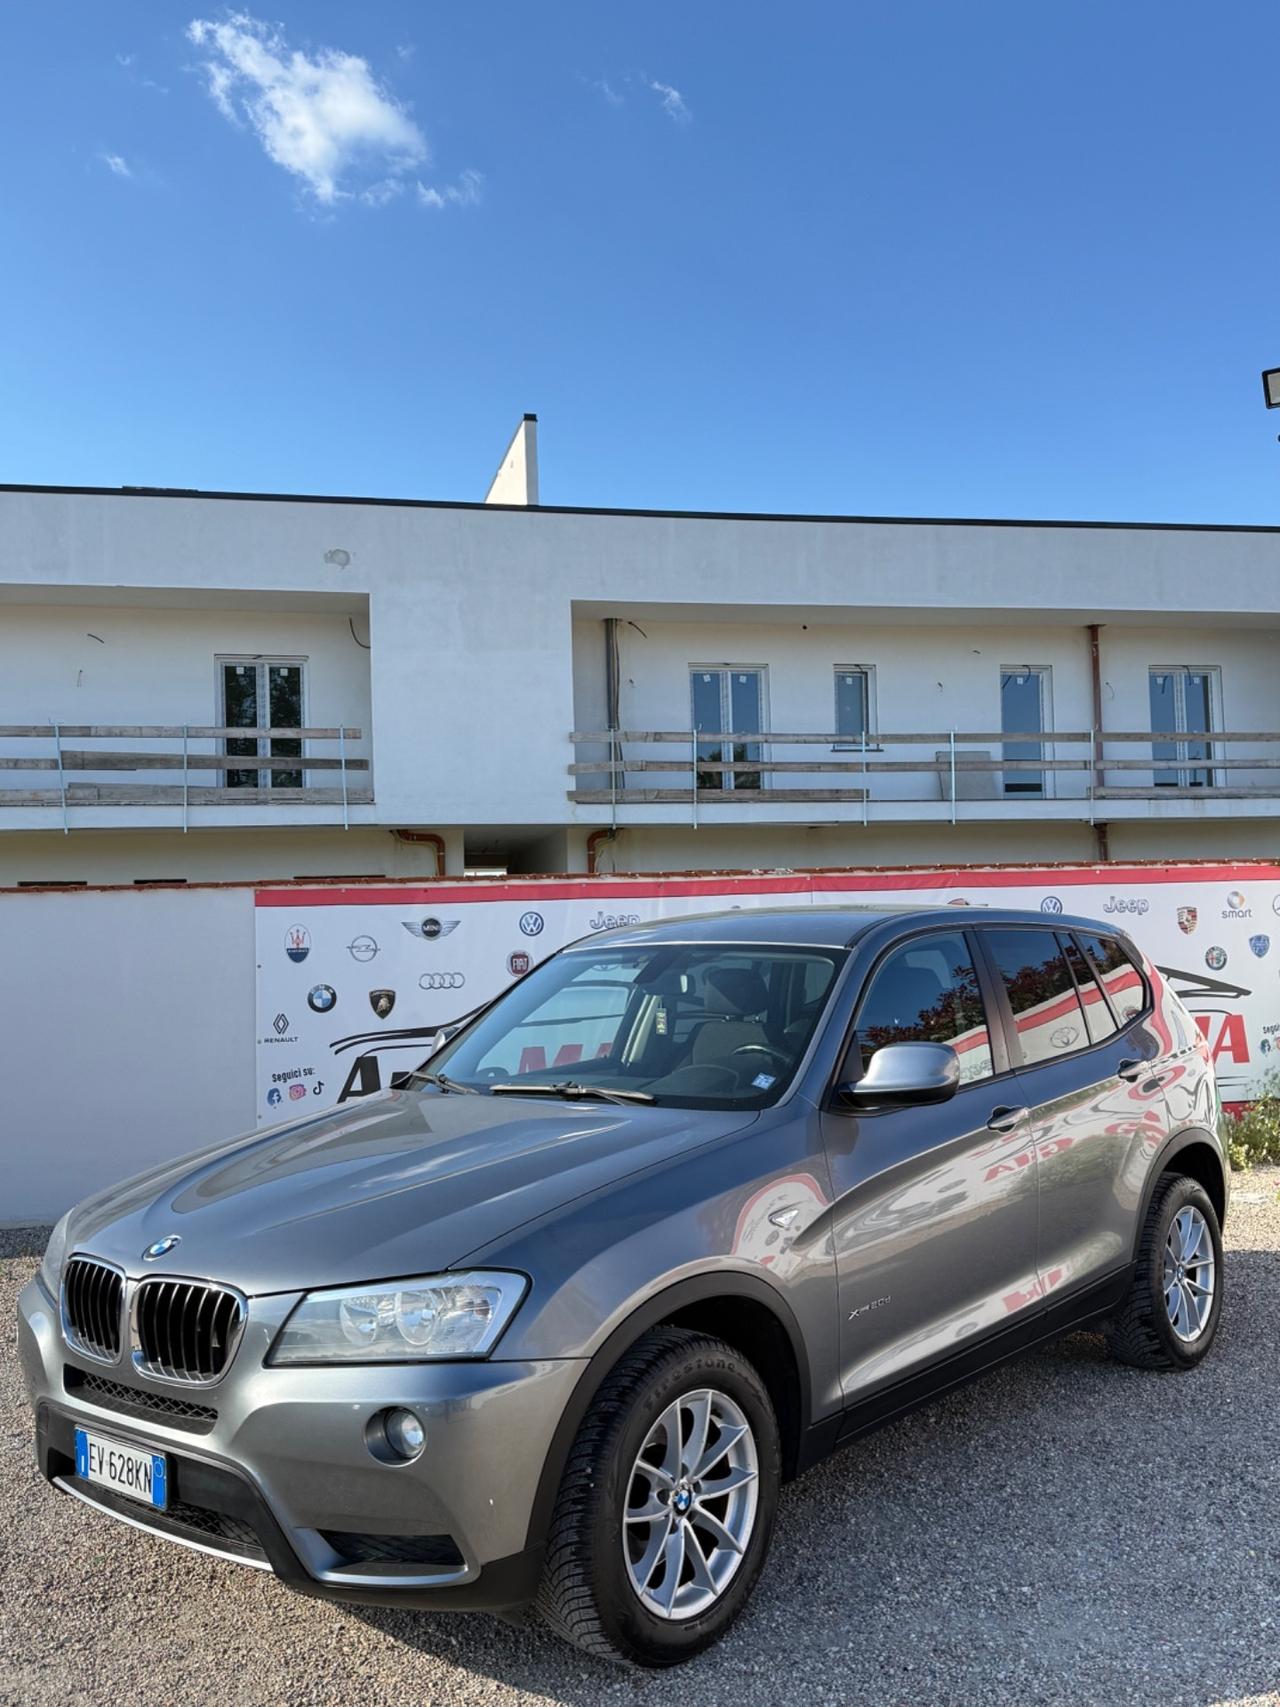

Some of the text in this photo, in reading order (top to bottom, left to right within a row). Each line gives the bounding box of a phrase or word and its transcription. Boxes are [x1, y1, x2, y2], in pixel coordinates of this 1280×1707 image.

[1103, 896, 1149, 915] Jeep
[1221, 908, 1252, 919] smart
[512, 958, 529, 971] FIAT
[272, 1067, 301, 1083] Seguici
[89, 1443, 152, 1493] EV 628KN
